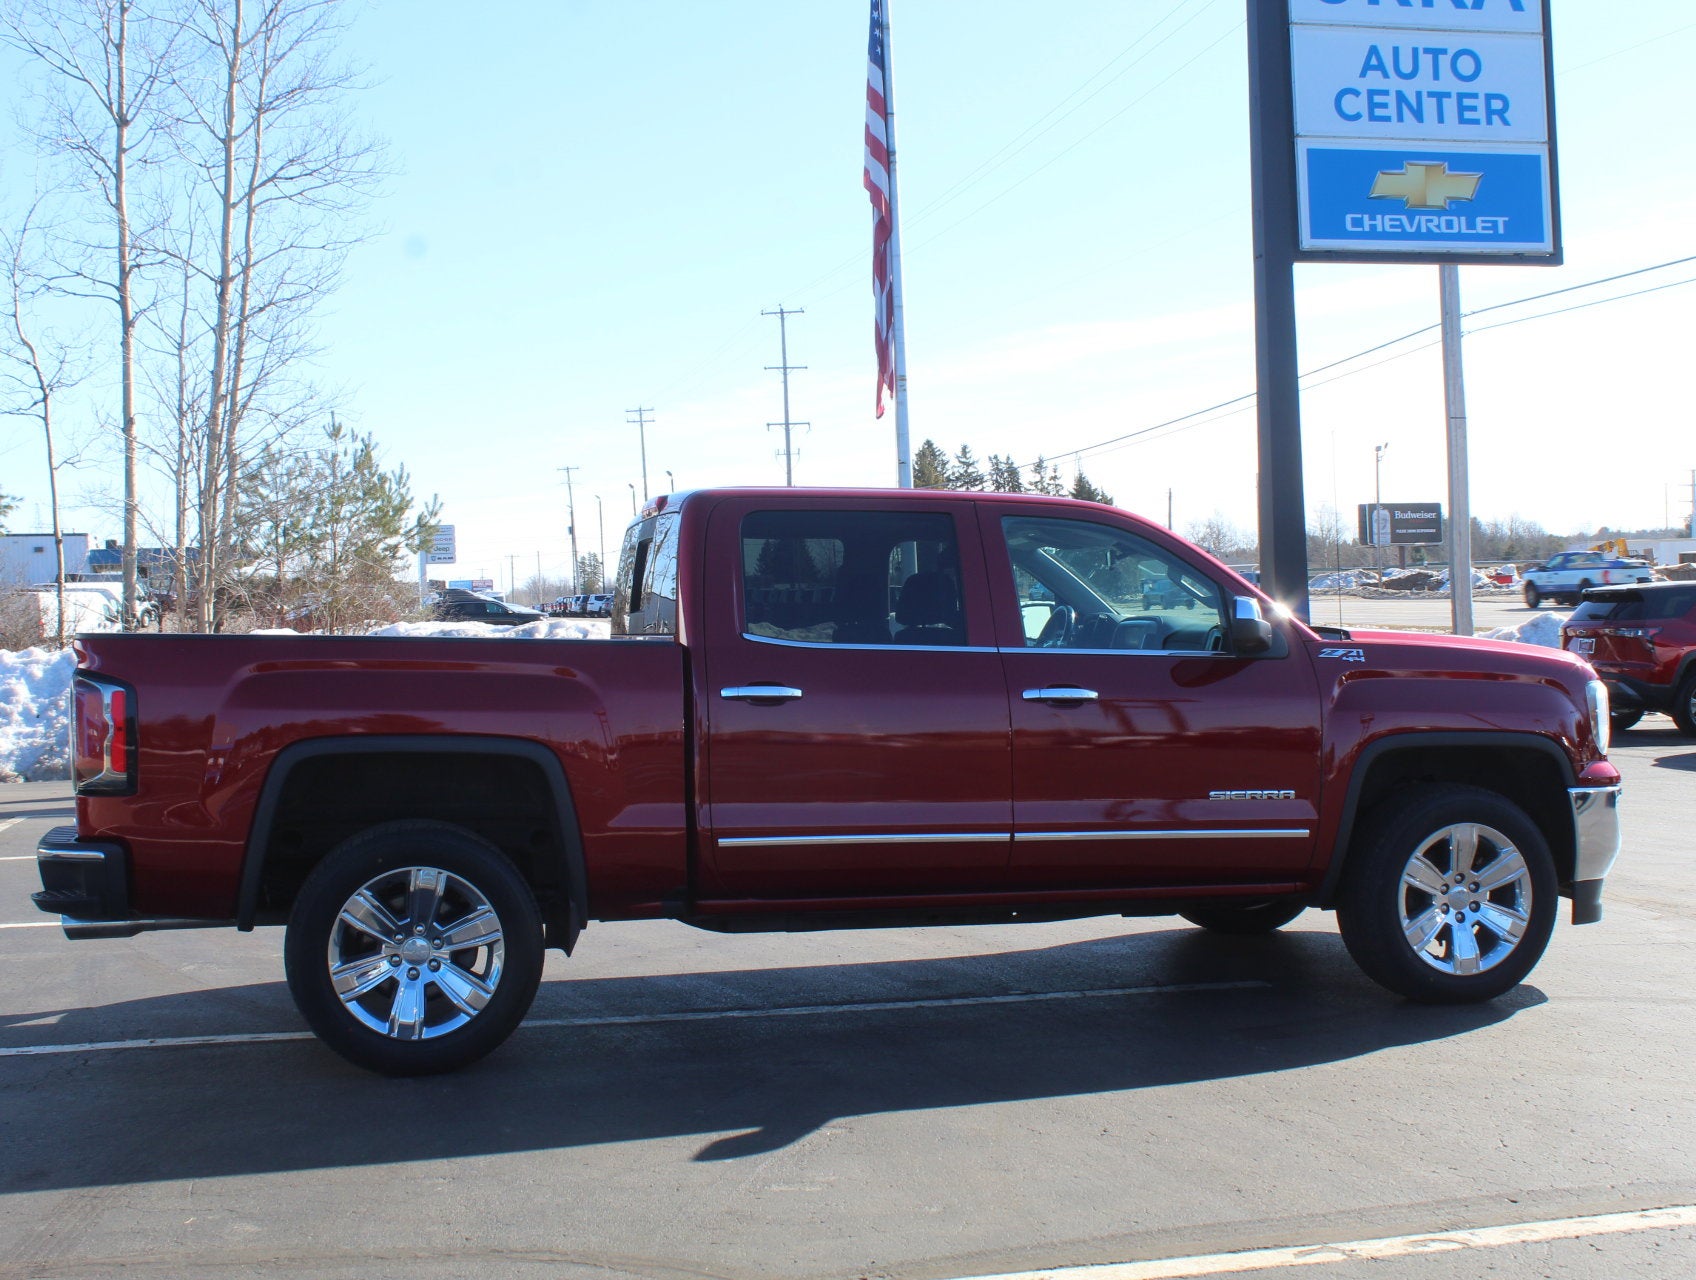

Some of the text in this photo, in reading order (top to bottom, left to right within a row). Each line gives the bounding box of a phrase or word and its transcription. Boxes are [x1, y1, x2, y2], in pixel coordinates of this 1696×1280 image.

[1359, 45, 1482, 82] AUTO
[1334, 87, 1511, 126] CENTER
[1345, 213, 1508, 234] CHEVROLET
[1394, 511, 1437, 519] Budweiser
[1209, 790, 1295, 800] SIERRA
